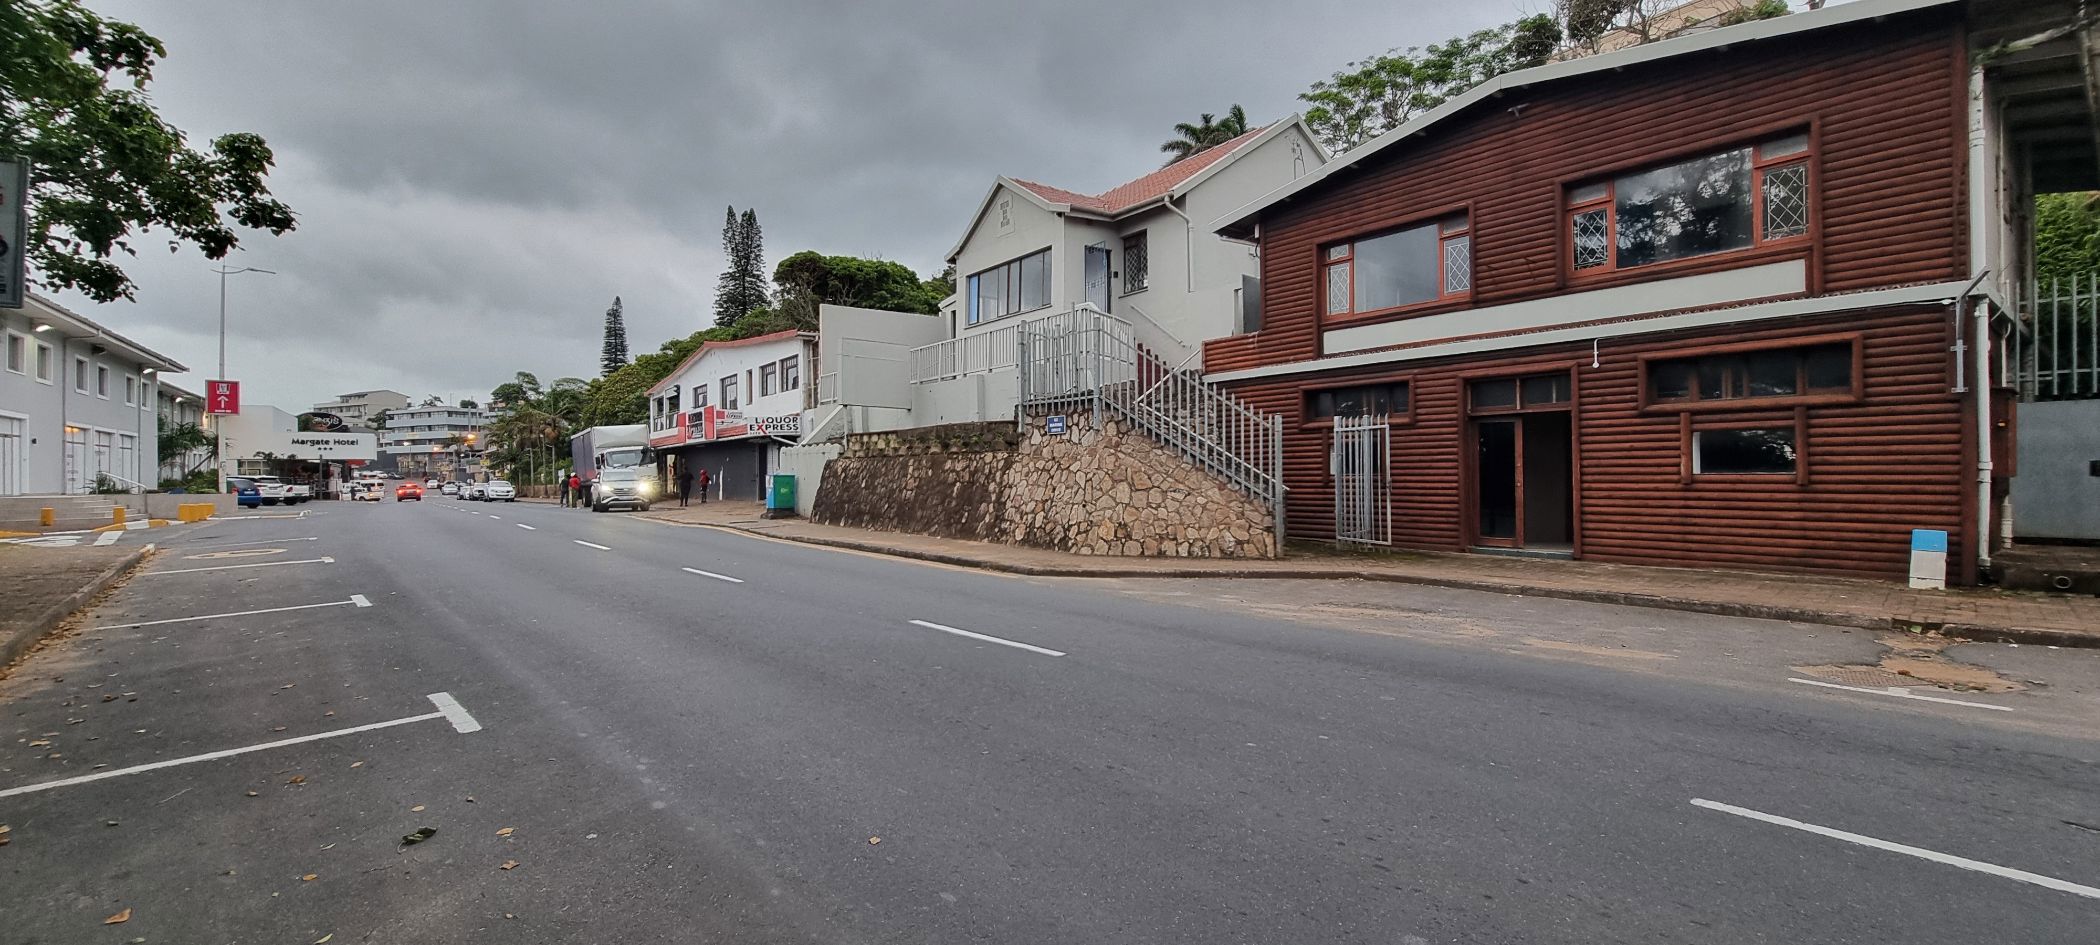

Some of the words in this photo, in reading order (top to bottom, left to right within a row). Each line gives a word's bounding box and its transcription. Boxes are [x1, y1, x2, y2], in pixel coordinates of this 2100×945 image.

[755, 416, 799, 424] LIQUOR
[750, 424, 799, 434] EXPRESS
[291, 438, 330, 446] Margate
